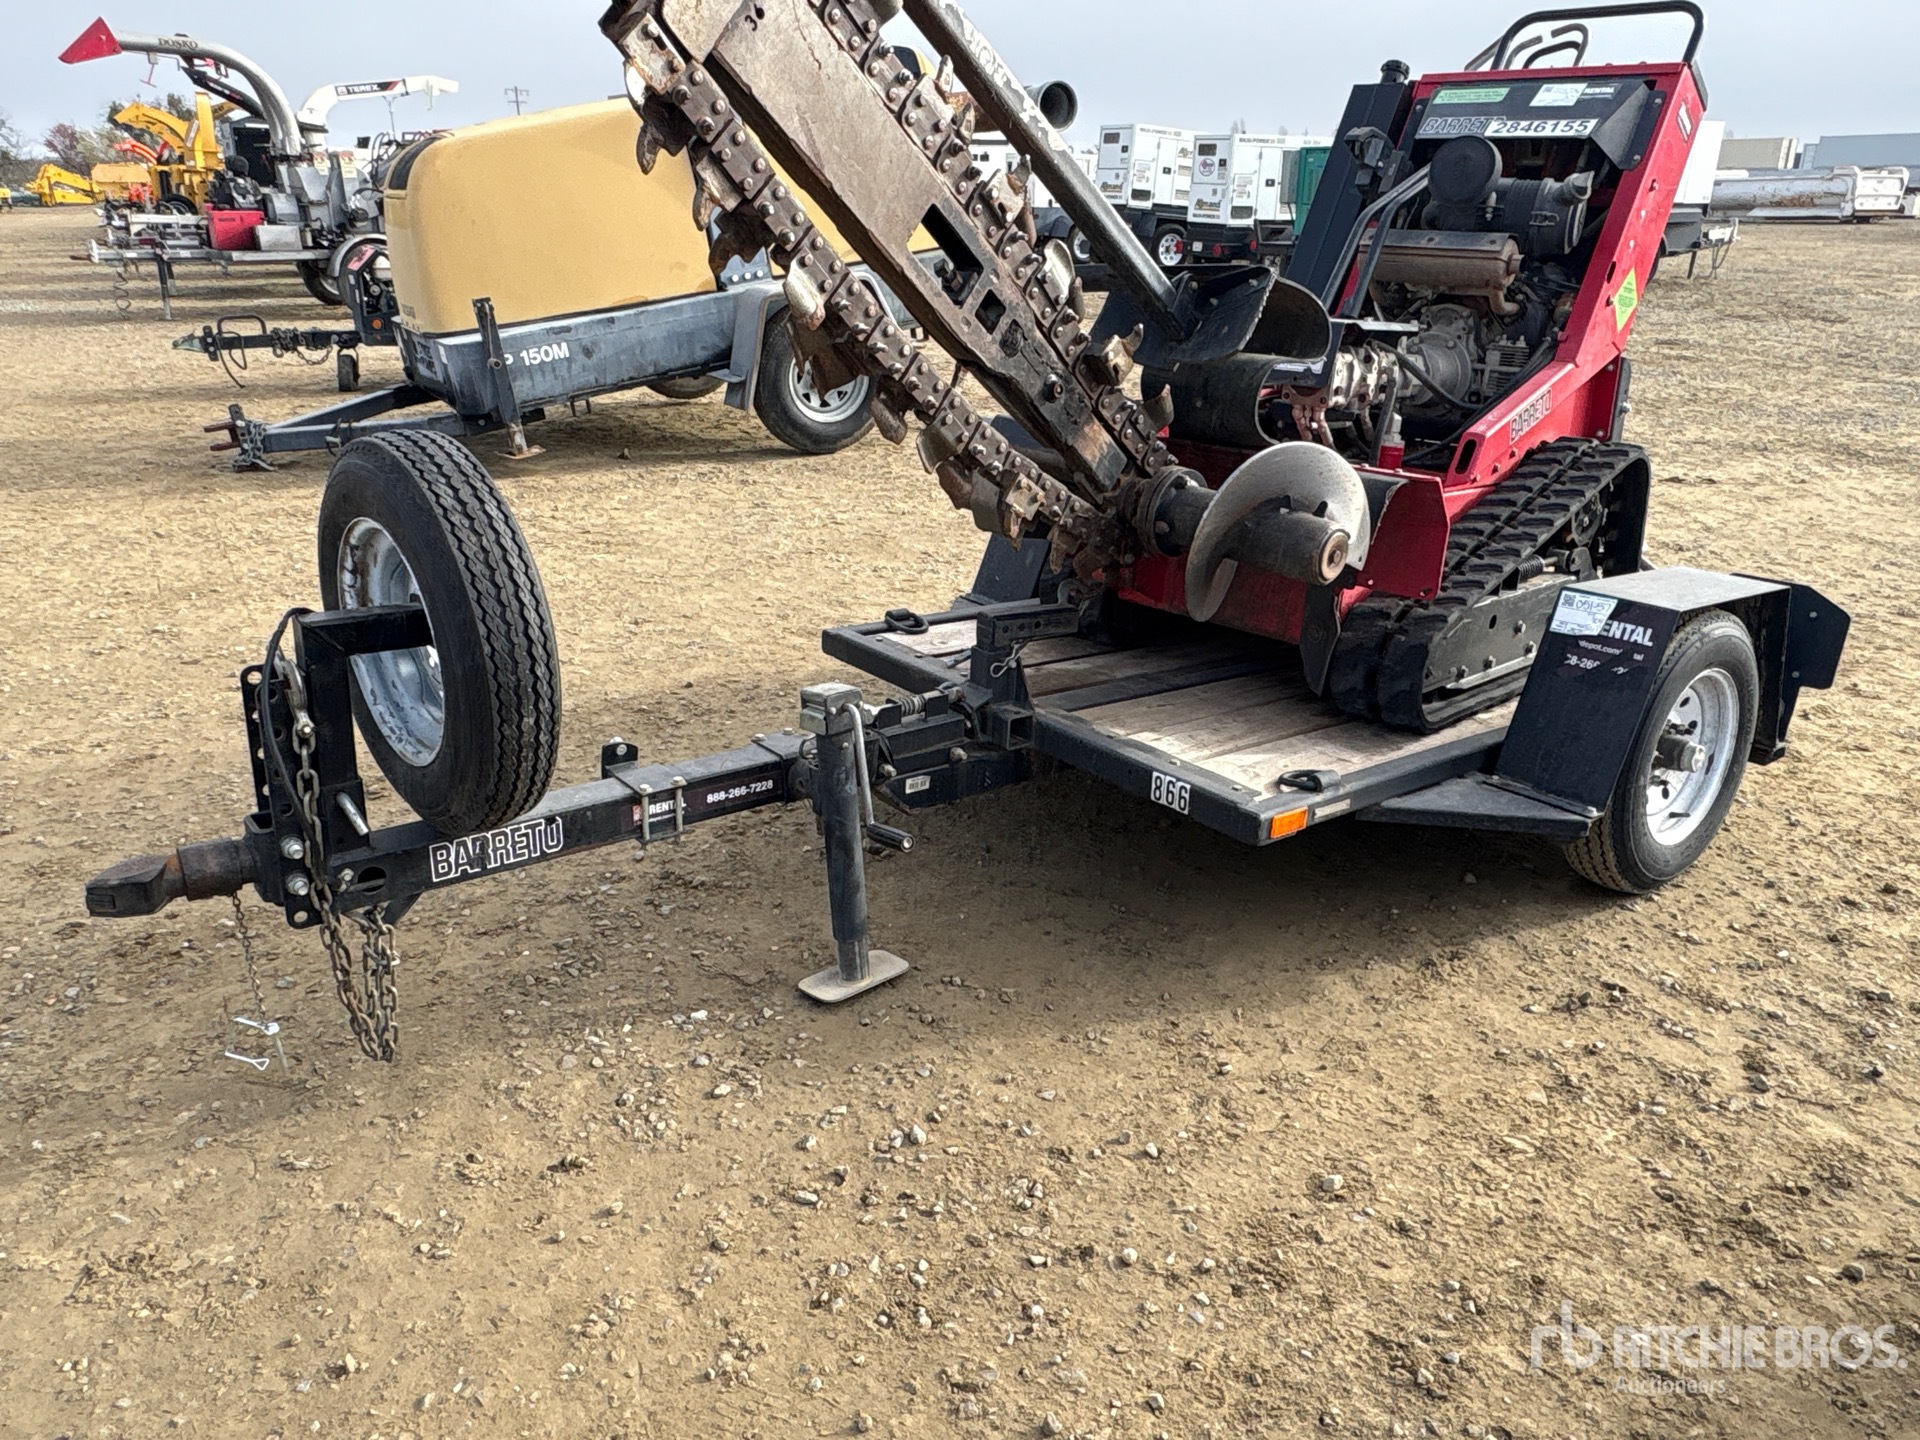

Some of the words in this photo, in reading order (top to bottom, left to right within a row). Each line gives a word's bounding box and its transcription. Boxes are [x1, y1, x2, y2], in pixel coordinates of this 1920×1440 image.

[158, 37, 198, 51] DOSKO
[1419, 115, 1507, 134] BARRET
[1492, 120, 1591, 134] 2846155
[520, 341, 570, 367] 150M
[1510, 387, 1552, 445] BARRETO
[1600, 619, 1653, 647] ENTAL
[648, 796, 687, 815] RENTL
[706, 779, 774, 804] 888-266-7228
[1153, 775, 1188, 812] 866
[429, 815, 564, 882] BARRETO
